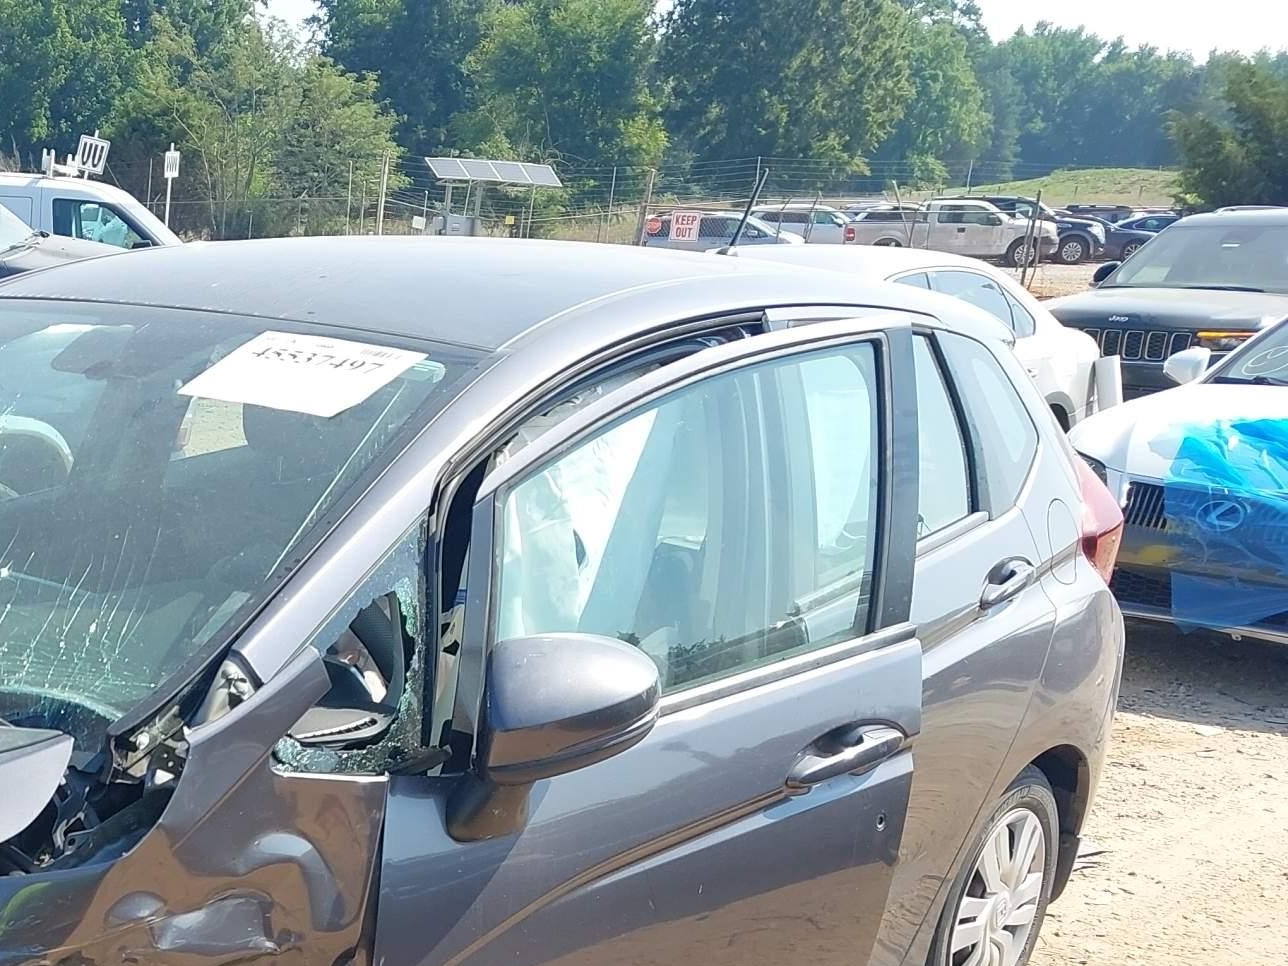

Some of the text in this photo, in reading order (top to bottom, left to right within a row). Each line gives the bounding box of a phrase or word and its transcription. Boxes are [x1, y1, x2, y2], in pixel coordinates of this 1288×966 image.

[81, 142, 105, 168] UU
[675, 215, 697, 225] KEEP
[675, 227, 693, 238] OUT
[252, 346, 385, 374] 45537497
